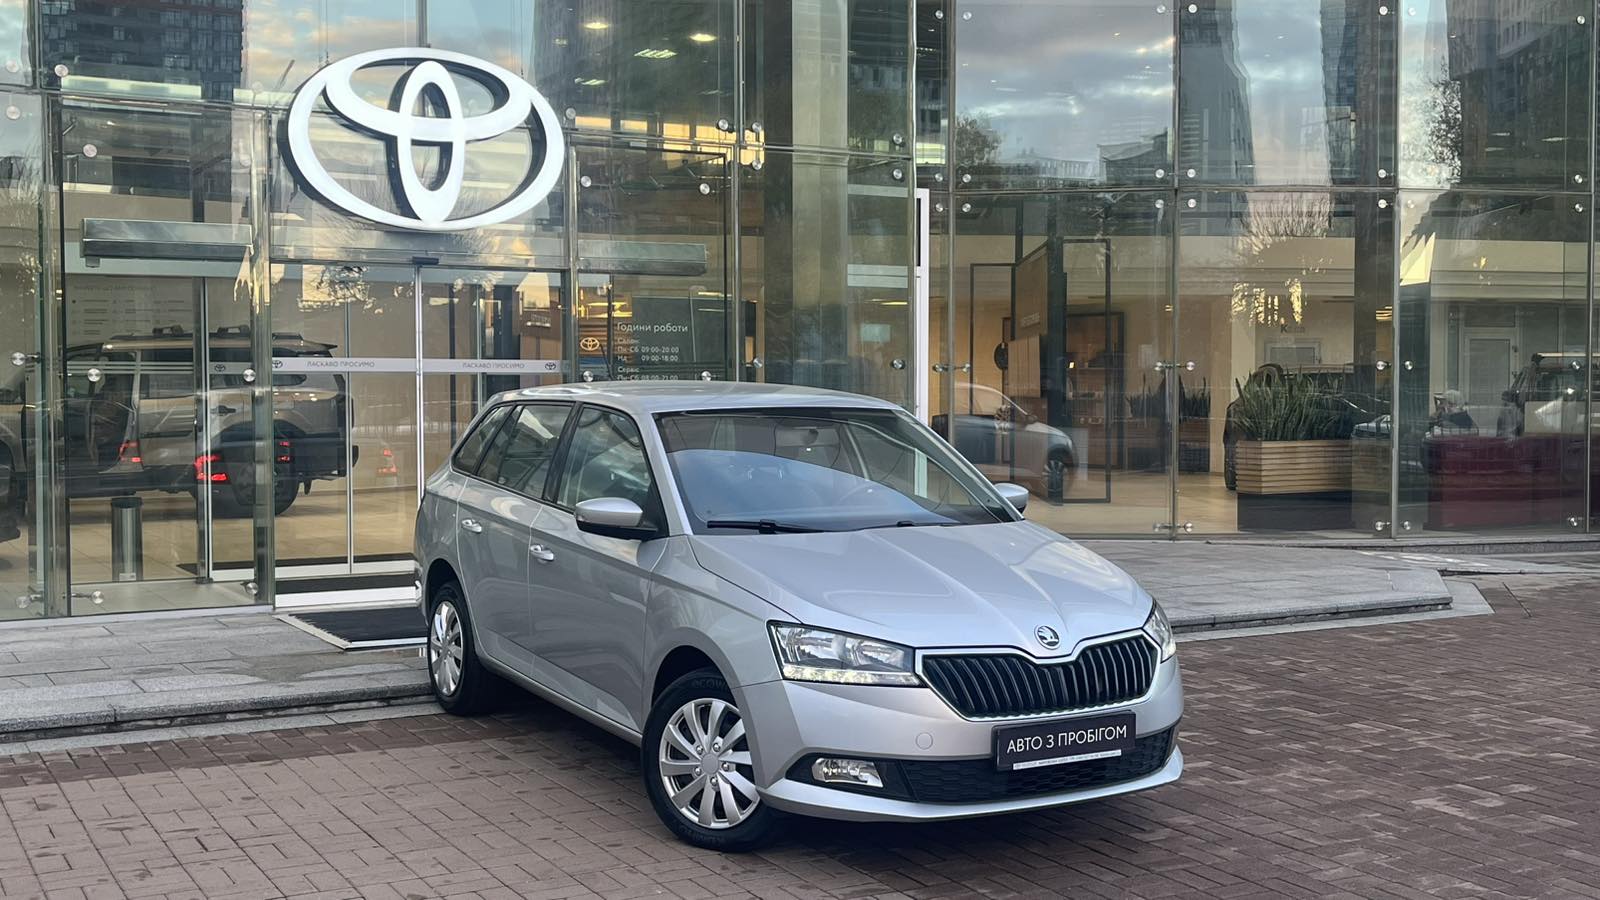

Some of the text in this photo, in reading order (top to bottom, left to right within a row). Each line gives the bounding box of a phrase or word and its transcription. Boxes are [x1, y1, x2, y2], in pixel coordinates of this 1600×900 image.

[617, 321, 688, 334] Години роботи
[1006, 736, 1043, 754] АВТО
[1058, 725, 1127, 747] ПРОБІГОМ
